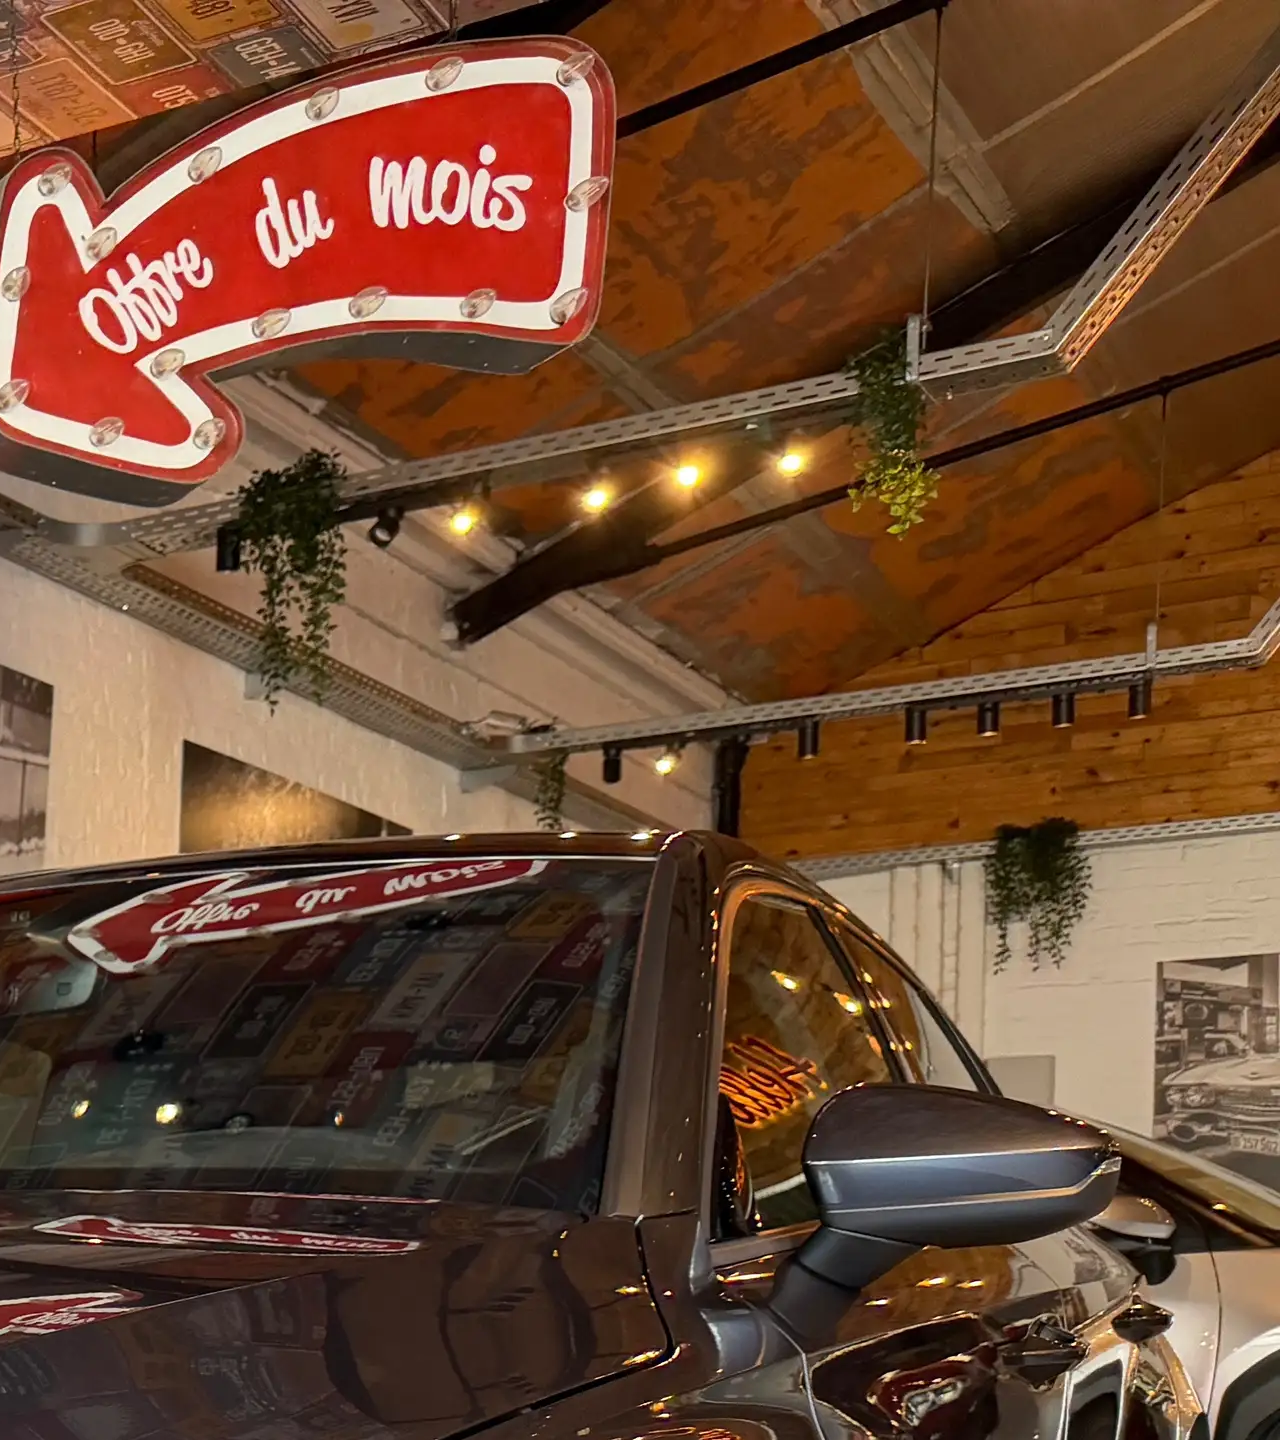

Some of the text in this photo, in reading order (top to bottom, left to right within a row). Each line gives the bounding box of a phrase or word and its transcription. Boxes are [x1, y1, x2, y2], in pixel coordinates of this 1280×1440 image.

[78, 144, 533, 354] Offre du mois
